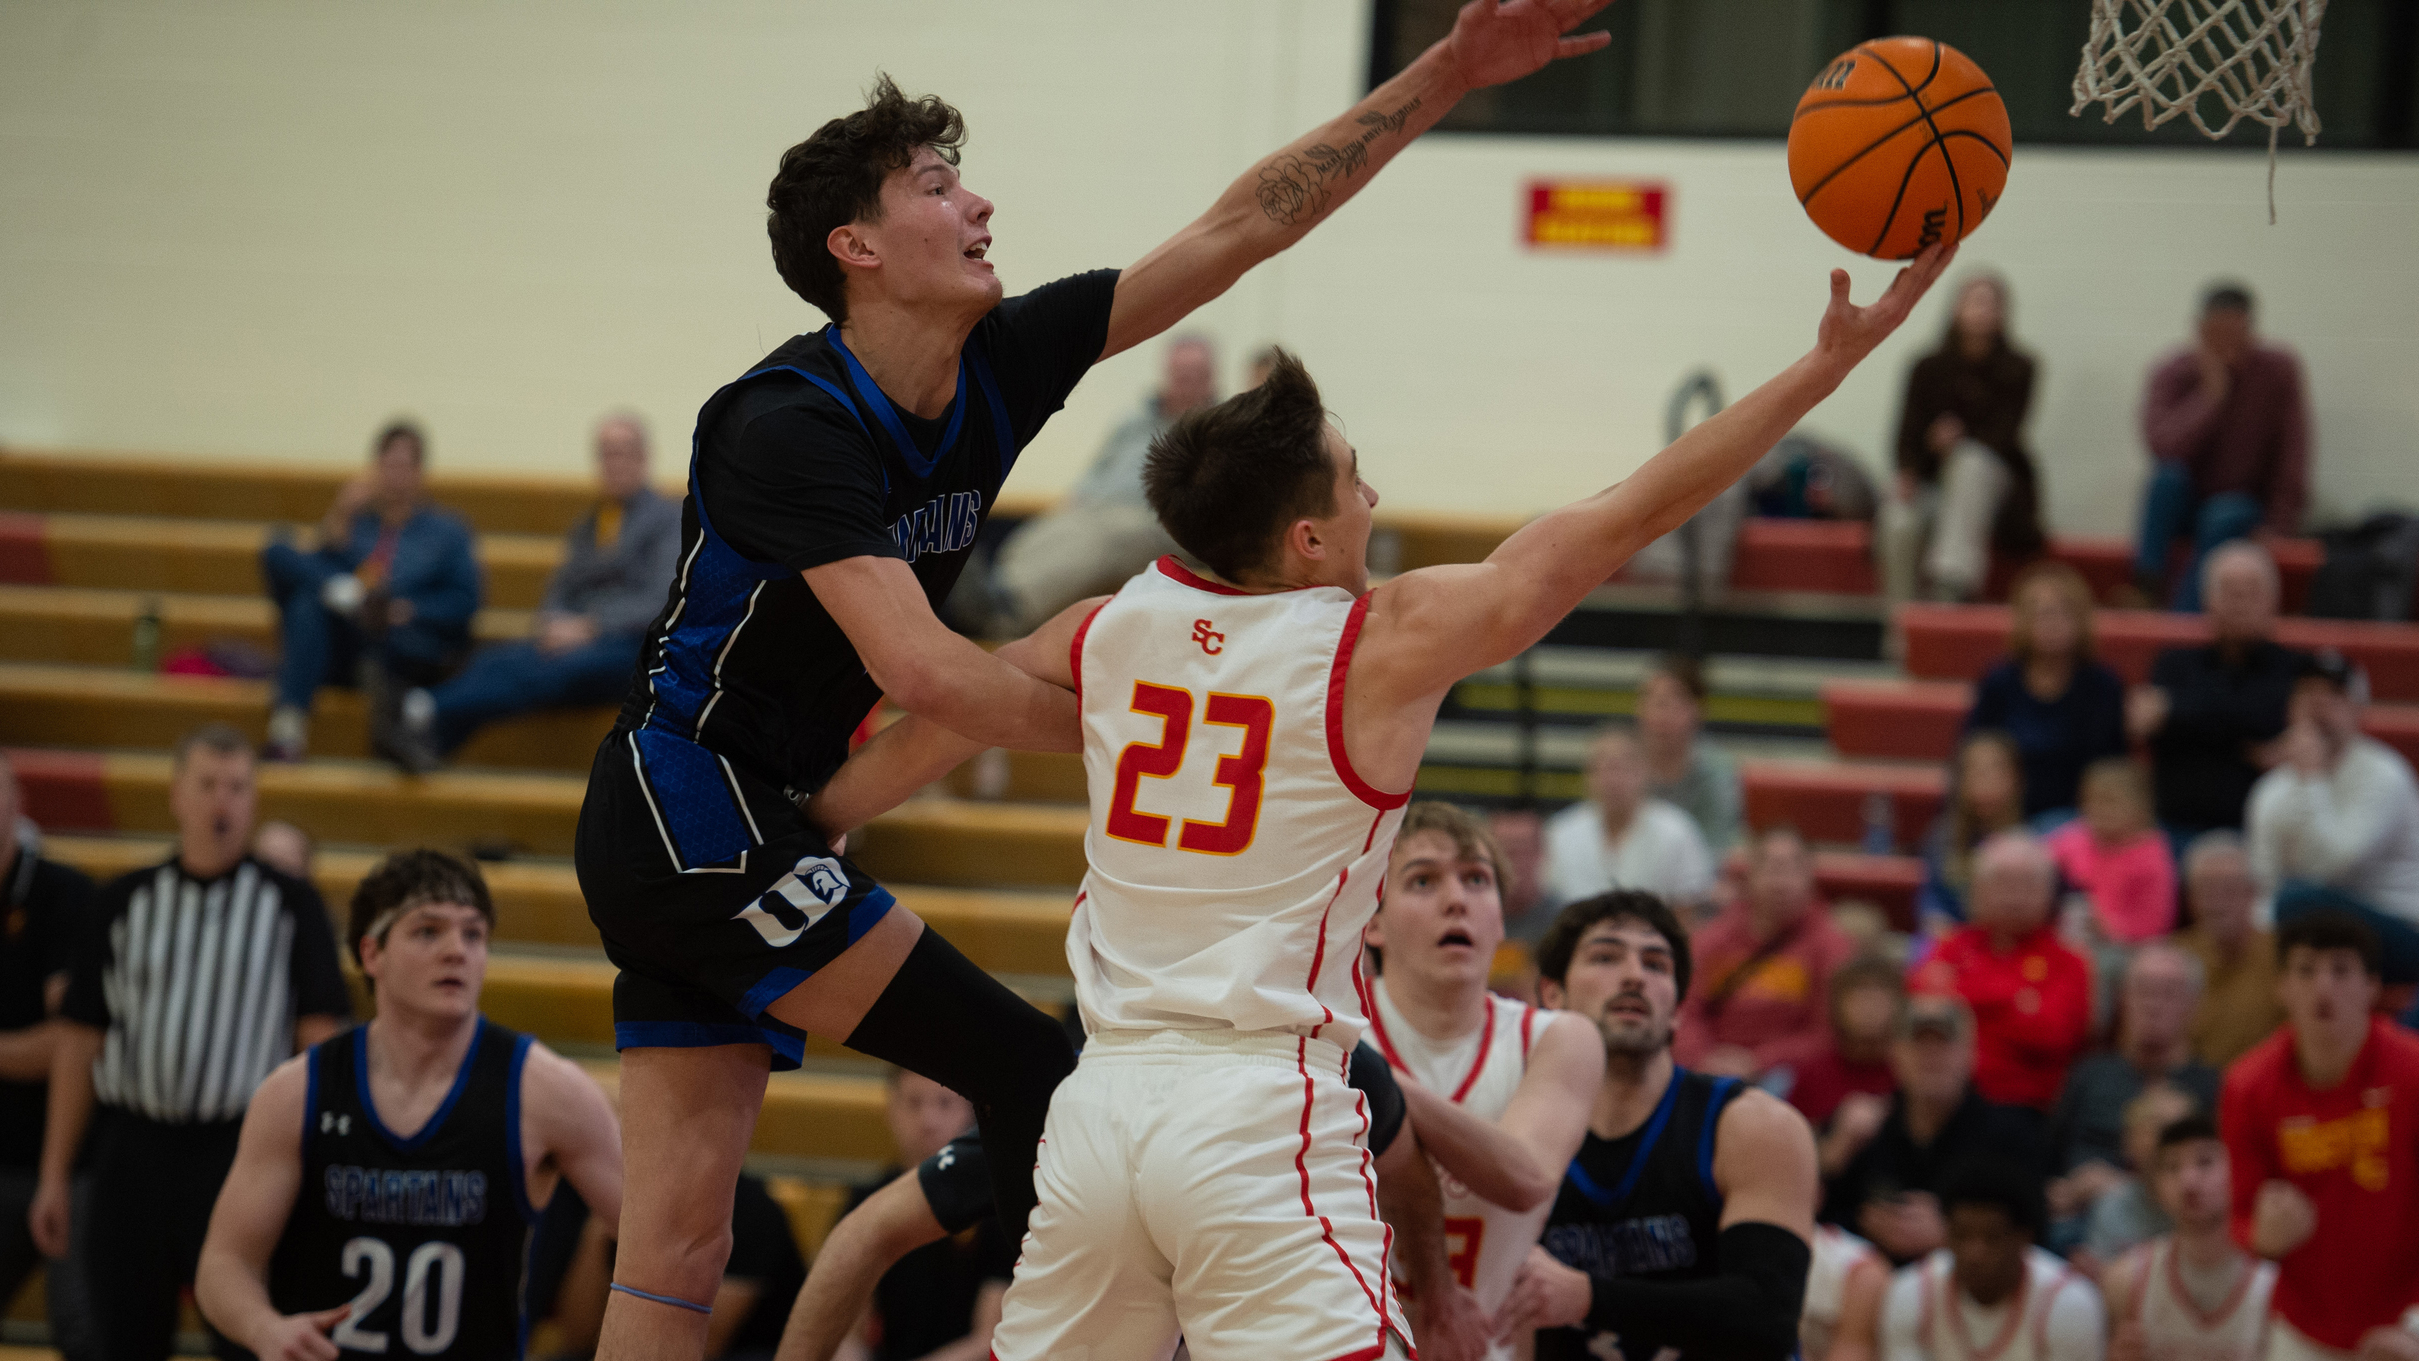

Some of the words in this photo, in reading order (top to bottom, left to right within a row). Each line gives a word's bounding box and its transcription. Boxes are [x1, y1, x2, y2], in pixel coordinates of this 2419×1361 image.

[1191, 618, 1226, 656] SC
[1105, 679, 1277, 858] 23
[324, 1163, 488, 1227] SPARTANS
[332, 1236, 466, 1356] 20
